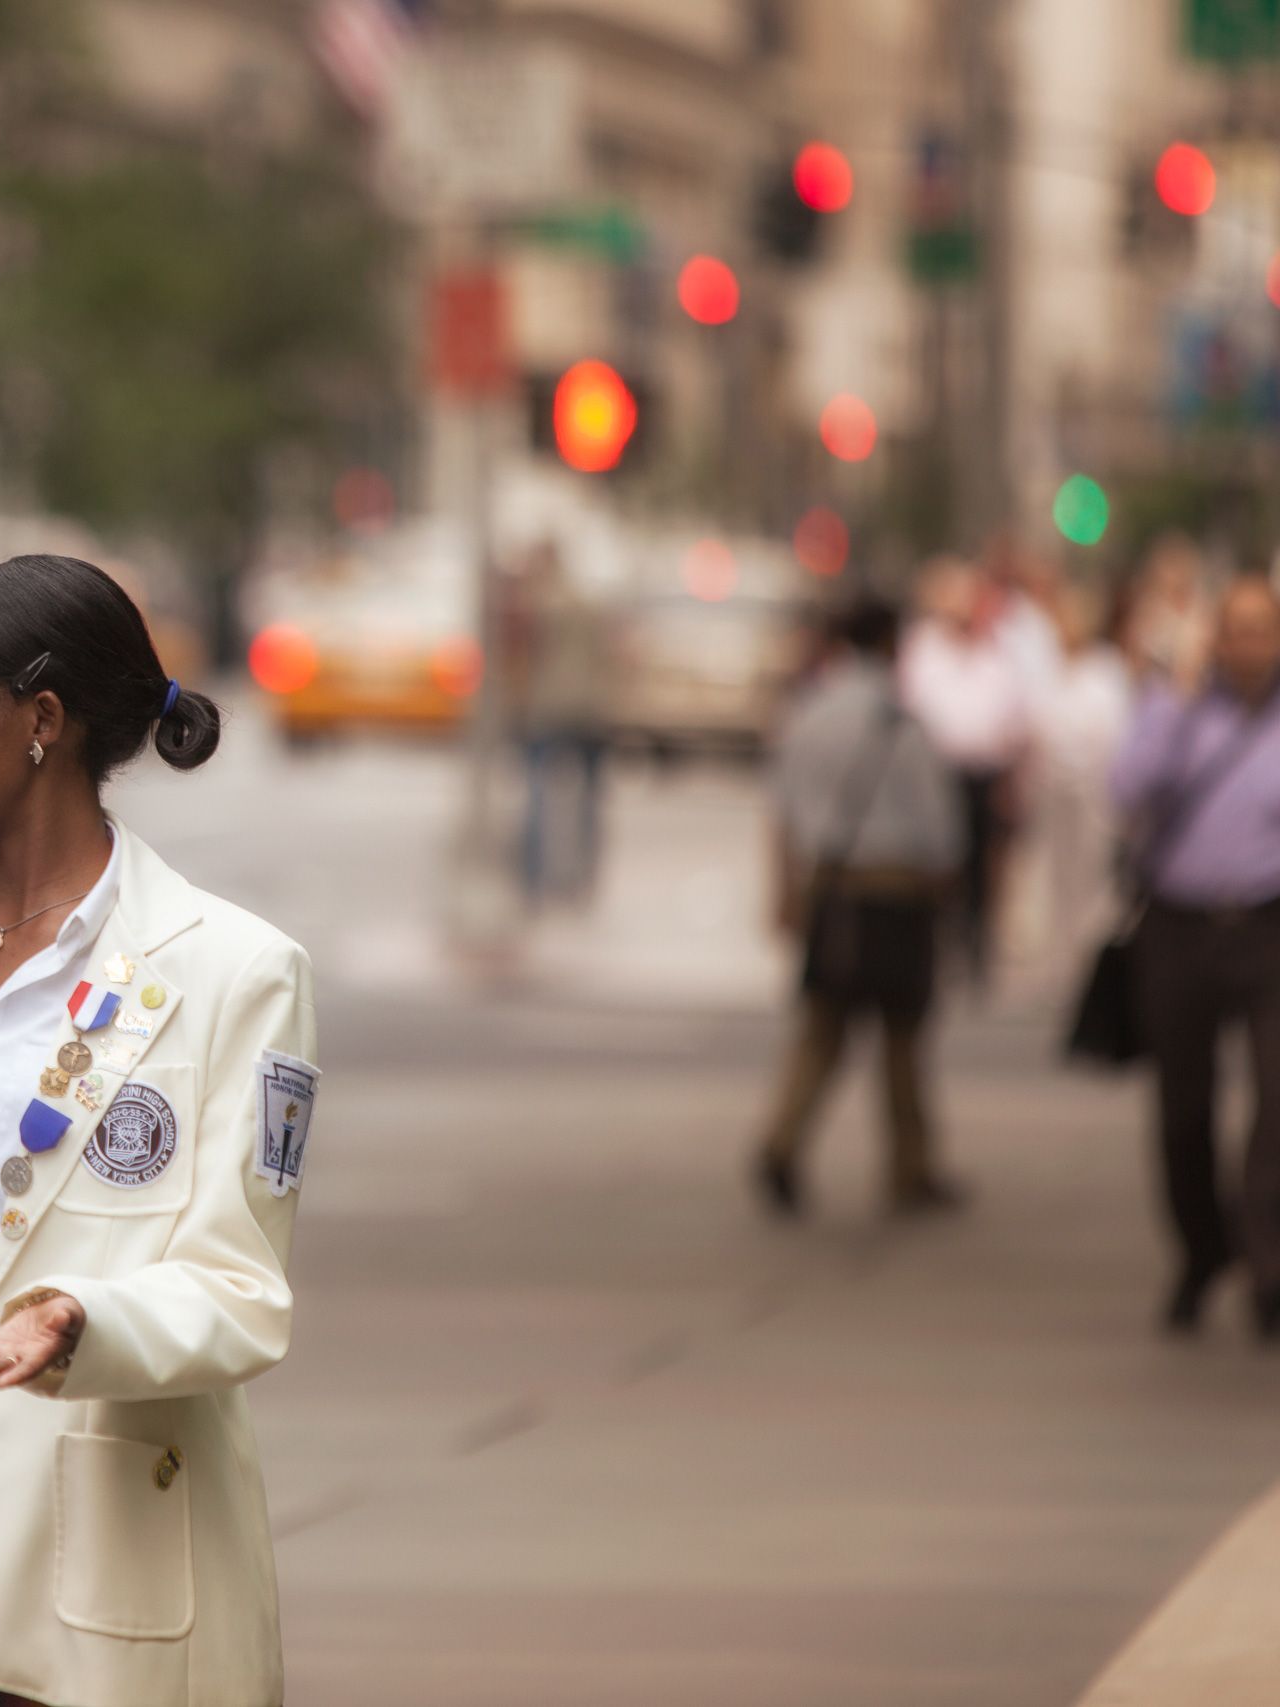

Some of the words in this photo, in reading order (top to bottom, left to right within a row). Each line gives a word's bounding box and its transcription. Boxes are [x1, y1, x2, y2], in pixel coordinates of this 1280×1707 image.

[118, 1086, 142, 1097] RINI
[142, 1088, 166, 1110] HIGH
[162, 1109, 175, 1152] SCHOOL
[91, 1156, 112, 1176] NEW
[111, 1171, 142, 1185] YORK
[142, 1161, 165, 1181] CITY
